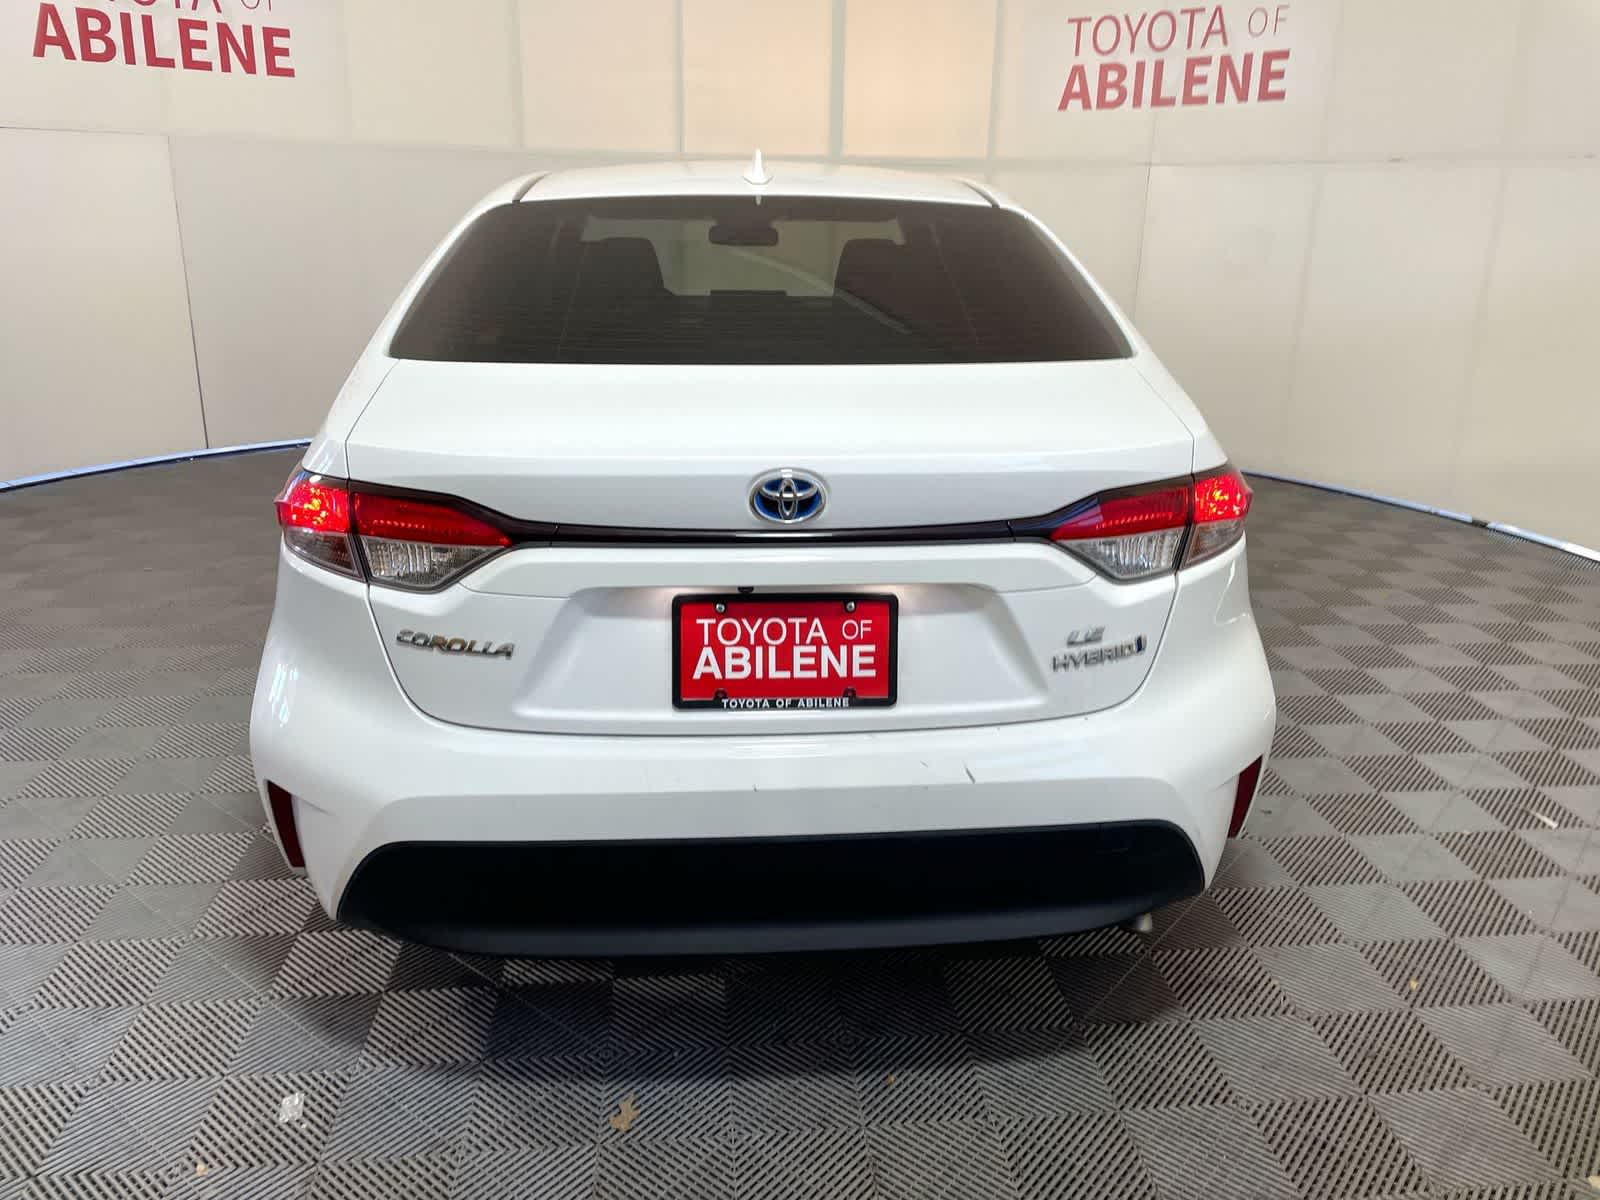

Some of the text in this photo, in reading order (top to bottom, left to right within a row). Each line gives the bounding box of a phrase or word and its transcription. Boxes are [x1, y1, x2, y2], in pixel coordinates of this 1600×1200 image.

[32, 2, 296, 77] ABILENE
[1067, 4, 1290, 56] TOYOTA OF
[1057, 49, 1291, 111] ABILENE
[396, 629, 515, 659] COROLLA
[696, 617, 873, 646] TOYOTA OF
[692, 644, 877, 680] ABILENE
[721, 697, 849, 709] TOYOTA OF ABILENE
